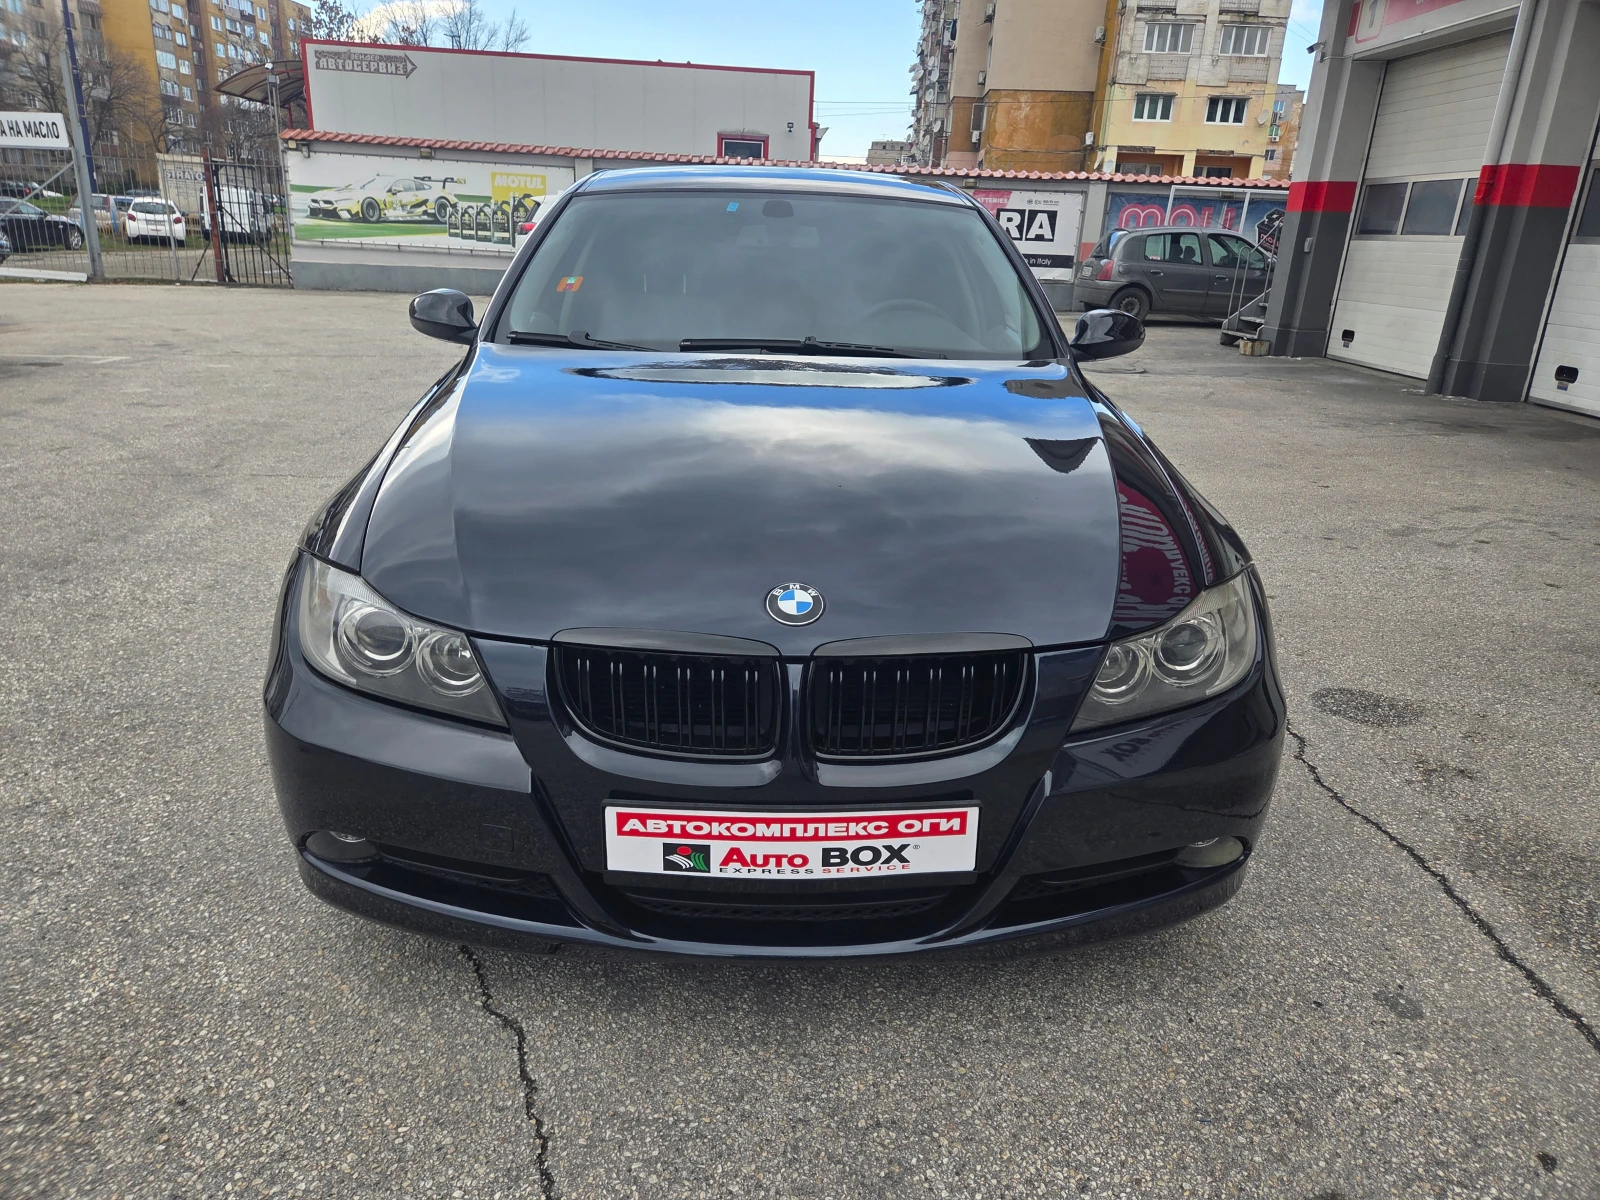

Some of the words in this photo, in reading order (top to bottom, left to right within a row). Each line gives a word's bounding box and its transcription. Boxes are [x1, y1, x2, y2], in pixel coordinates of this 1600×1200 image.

[320, 58, 405, 75] АВТОСЕРВИЗ
[6, 120, 24, 138] НА
[22, 120, 60, 139] МАСЛО
[165, 169, 206, 181] STRATO
[494, 175, 544, 188] MOTUL
[1000, 211, 1054, 239] RA
[1036, 257, 1052, 266] Italy
[773, 584, 820, 596] BMW
[621, 818, 890, 838] АВТОКОМПЛЕКС
[897, 818, 962, 834] ОГИ
[719, 867, 815, 875] EXPRESS
[822, 863, 912, 875] SERVICE
